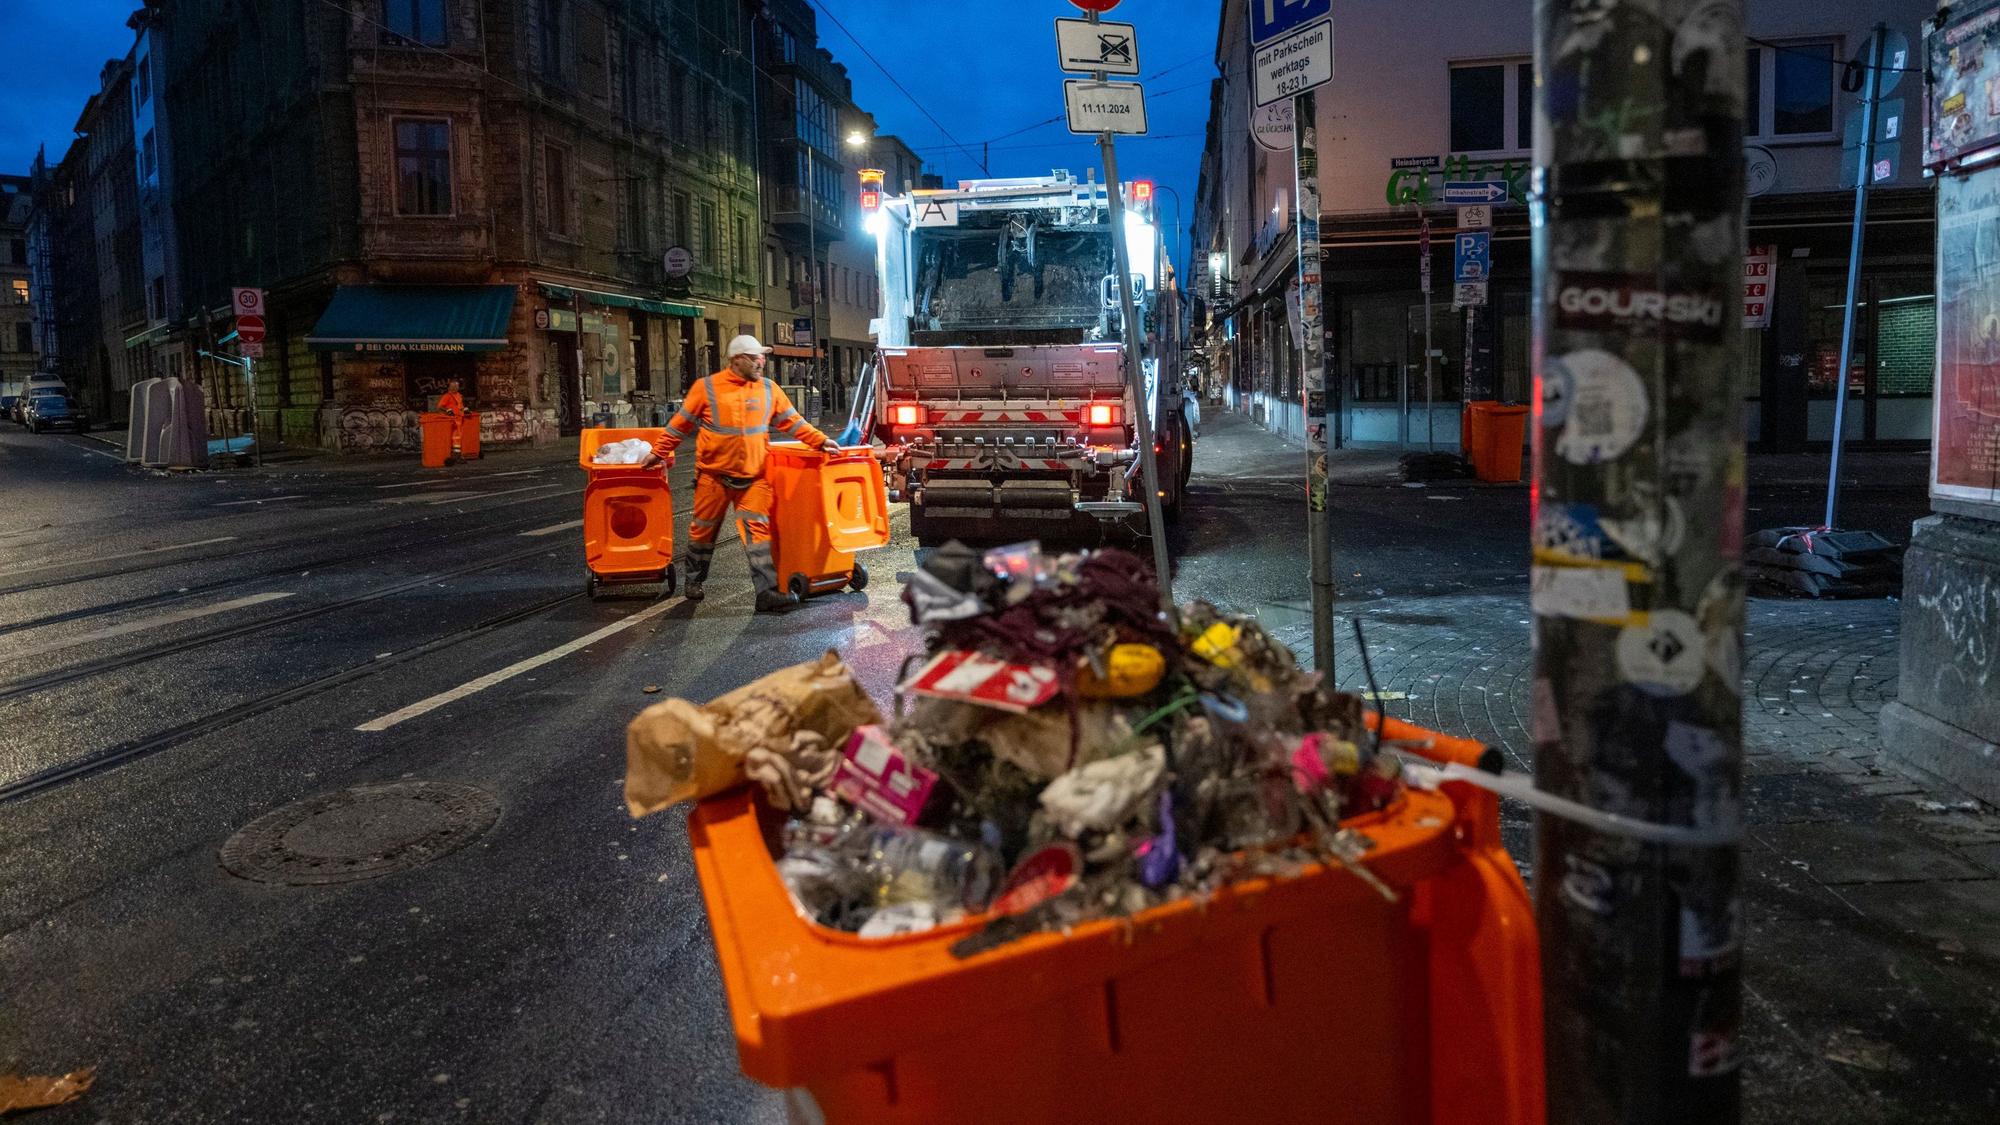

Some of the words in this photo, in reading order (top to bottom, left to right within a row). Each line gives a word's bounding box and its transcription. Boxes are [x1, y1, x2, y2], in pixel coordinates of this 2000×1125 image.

[1258, 52, 1272, 69] mit
[1273, 31, 1324, 61] Parkschein
[1270, 55, 1310, 81] werktags
[1276, 77, 1300, 96] 18-23
[1301, 73, 1308, 86] h
[1081, 103, 1131, 114] 11.11.2024
[1256, 122, 1295, 134] GLÜCKSHU
[921, 201, 947, 222] A
[1460, 236, 1475, 256] P
[1757, 263, 1766, 276] €
[1753, 284, 1761, 296] €
[242, 295, 254, 304] 30
[1751, 304, 1760, 316] €
[383, 344, 407, 352] OMA
[408, 343, 465, 352] KLEINMANN
